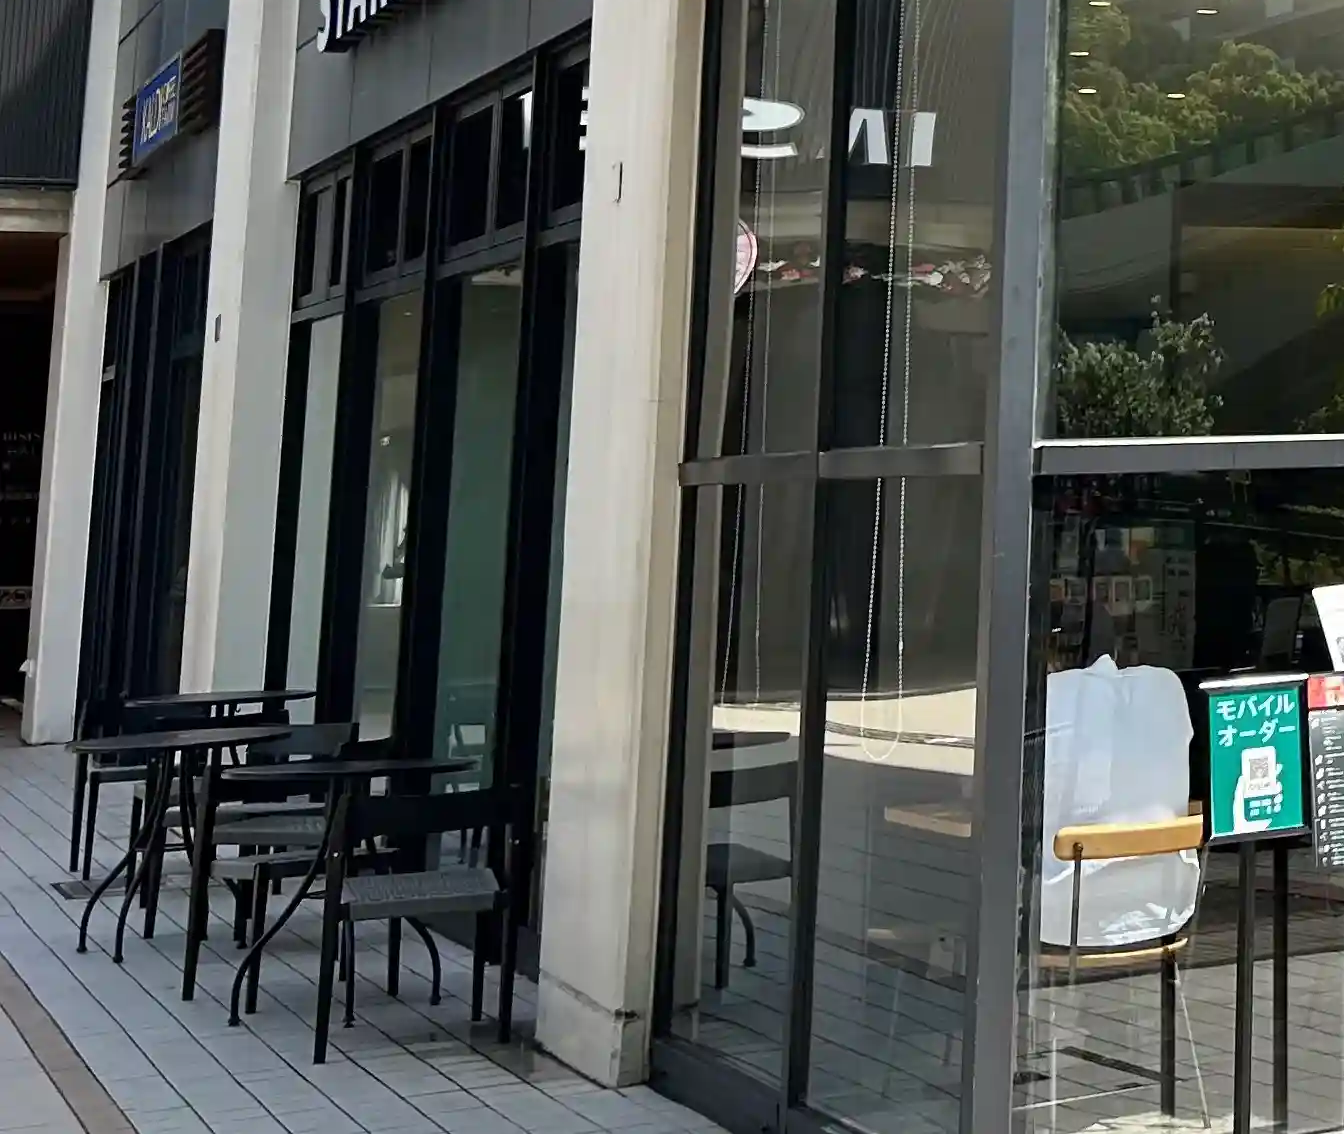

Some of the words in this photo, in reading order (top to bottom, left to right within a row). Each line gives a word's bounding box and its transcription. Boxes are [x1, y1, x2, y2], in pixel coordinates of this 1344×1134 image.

[1215, 693, 1296, 721] モバイル
[1217, 717, 1297, 748] オーダー
